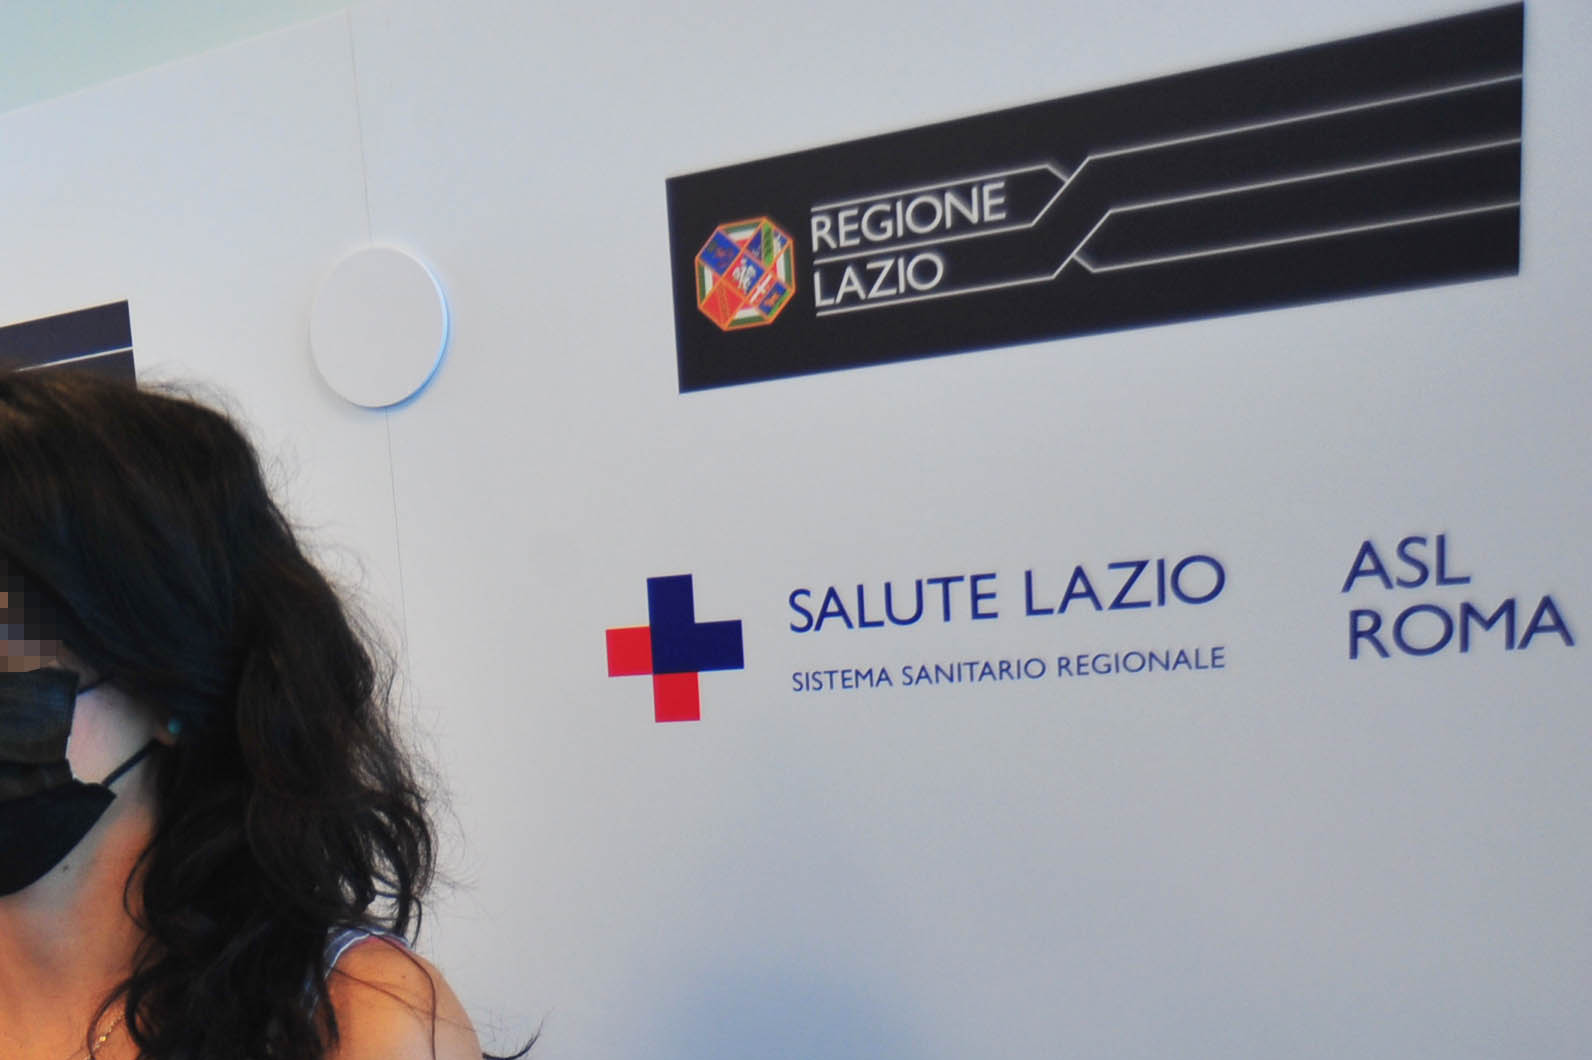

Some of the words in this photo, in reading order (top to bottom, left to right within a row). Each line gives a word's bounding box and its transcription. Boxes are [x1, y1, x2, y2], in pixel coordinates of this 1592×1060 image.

[811, 181, 1007, 252] REGIONE
[813, 253, 944, 307] LAZIO
[787, 572, 999, 633] SALUTE
[1024, 554, 1226, 616] LAZIO
[1340, 534, 1471, 593] ASL
[1349, 595, 1575, 660] ROMA
[791, 667, 894, 692] SISTEMA
[901, 656, 1047, 686] SANITARIO
[1057, 646, 1226, 678] REGIONALE
